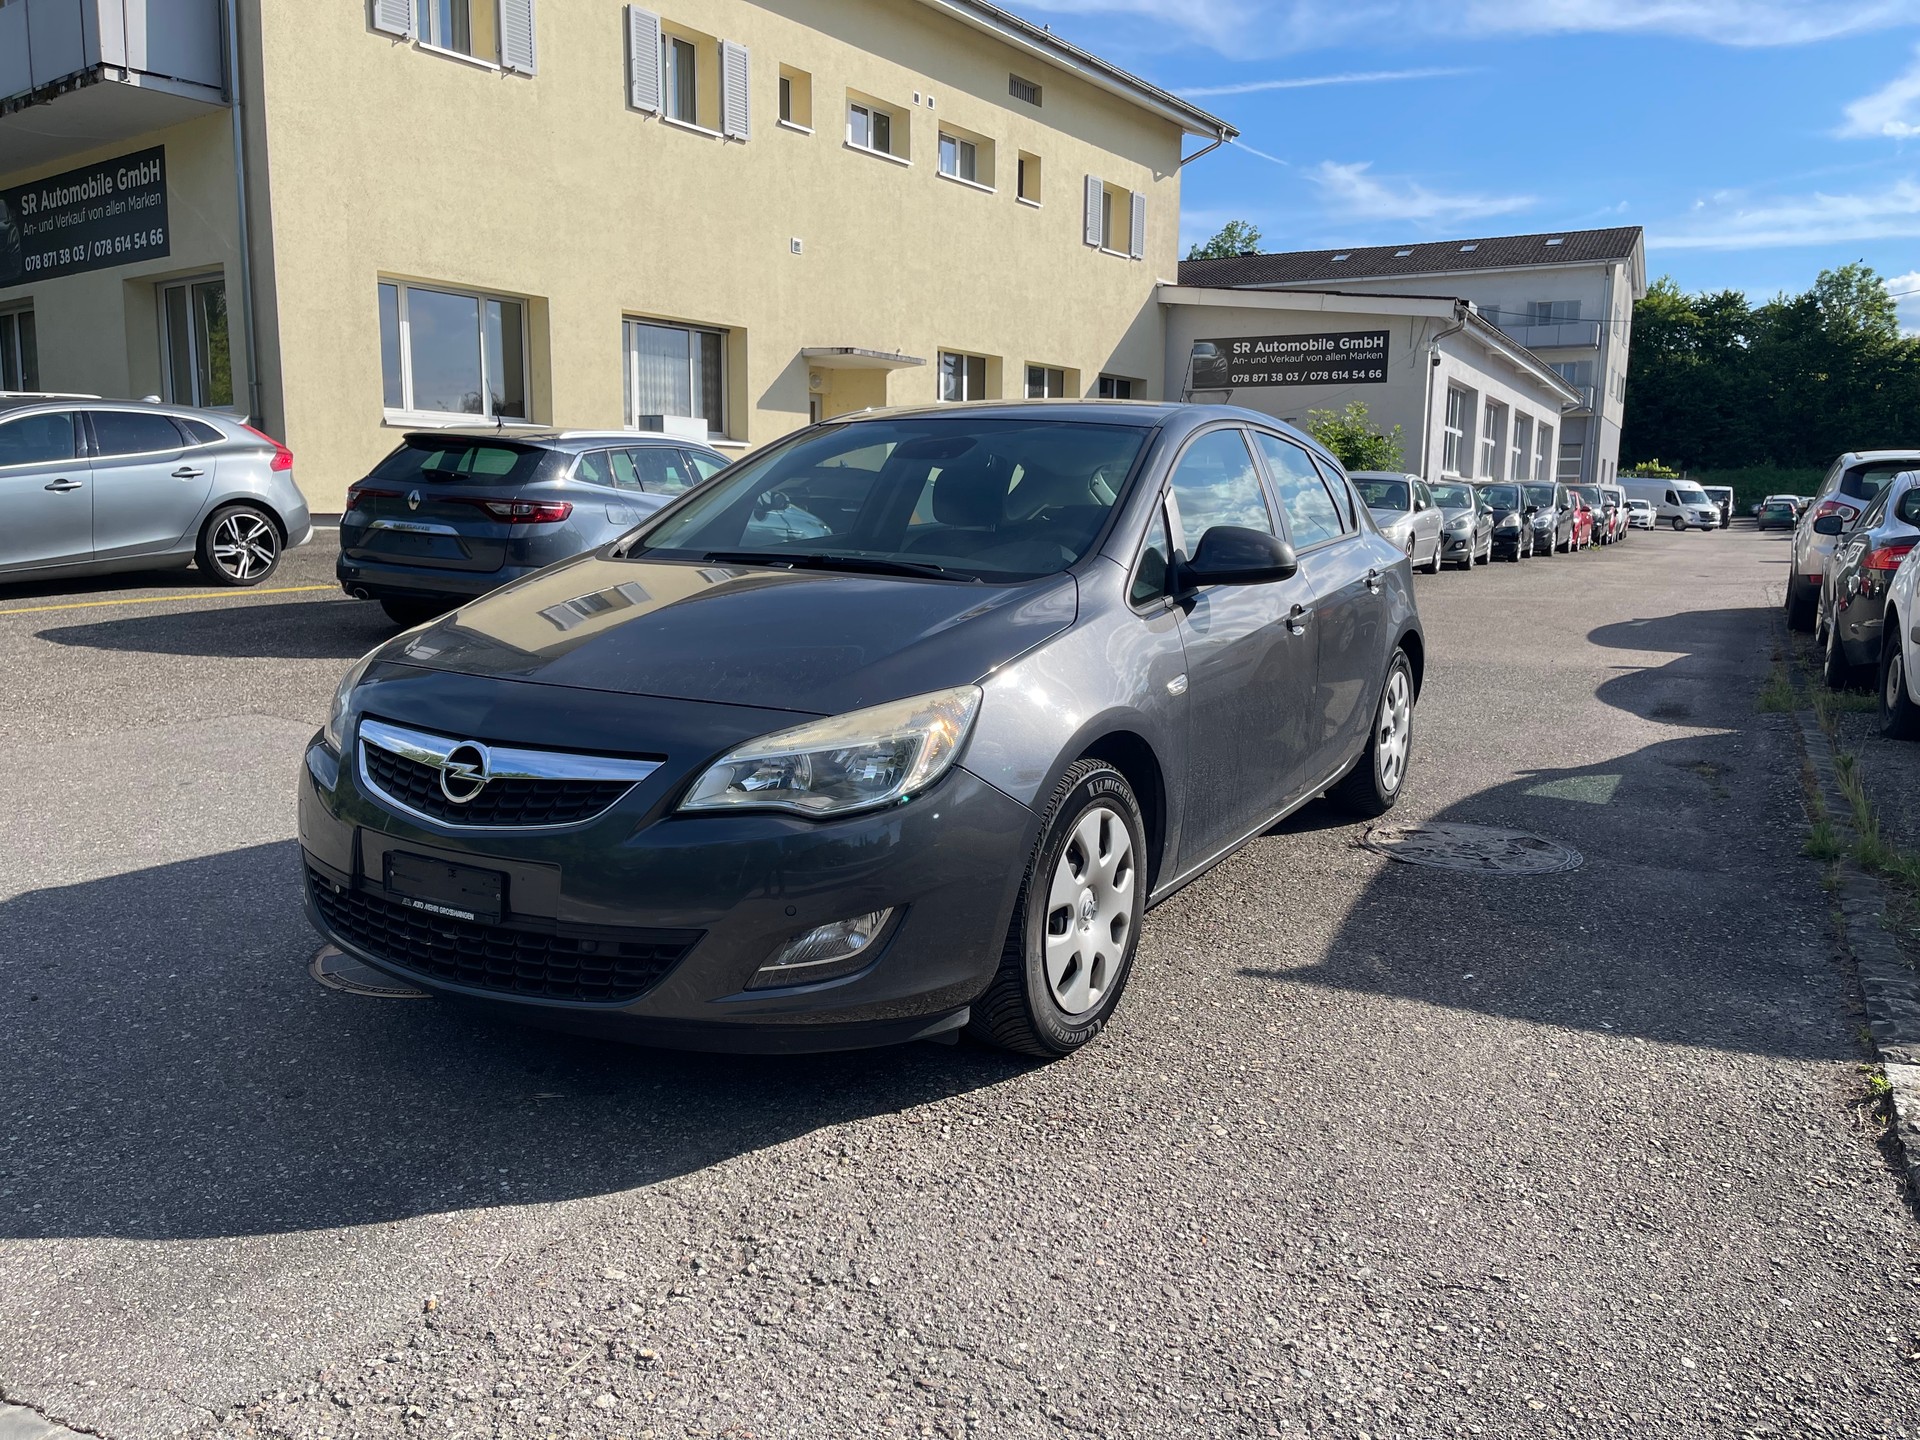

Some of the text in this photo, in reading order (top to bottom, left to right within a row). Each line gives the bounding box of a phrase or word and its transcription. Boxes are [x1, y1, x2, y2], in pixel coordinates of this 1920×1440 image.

[21, 158, 160, 216] SR Automobile GmbH
[23, 192, 161, 236] An- und Verkauf von allen Marken
[25, 254, 41, 271] 078
[43, 251, 57, 268] 871
[59, 248, 70, 265] 38
[73, 244, 84, 262] 03
[94, 236, 112, 257] 078
[114, 233, 131, 253] 614
[134, 230, 147, 249] 54
[150, 227, 163, 246] 66
[1232, 351, 1383, 365] An- und Verkauf von allen Marken
[1233, 336, 1384, 354] SR Automobile GmbH
[1231, 374, 1250, 383] 078
[1252, 373, 1268, 382] 871
[1270, 373, 1283, 382] 38
[1285, 372, 1299, 381] 03
[1310, 371, 1329, 381] 078
[1331, 370, 1349, 380] 614
[1352, 370, 1365, 379] 54
[1368, 369, 1382, 378] 66
[1103, 779, 1138, 814] MICHELIN
[1046, 1017, 1088, 1044] MICHELIN
